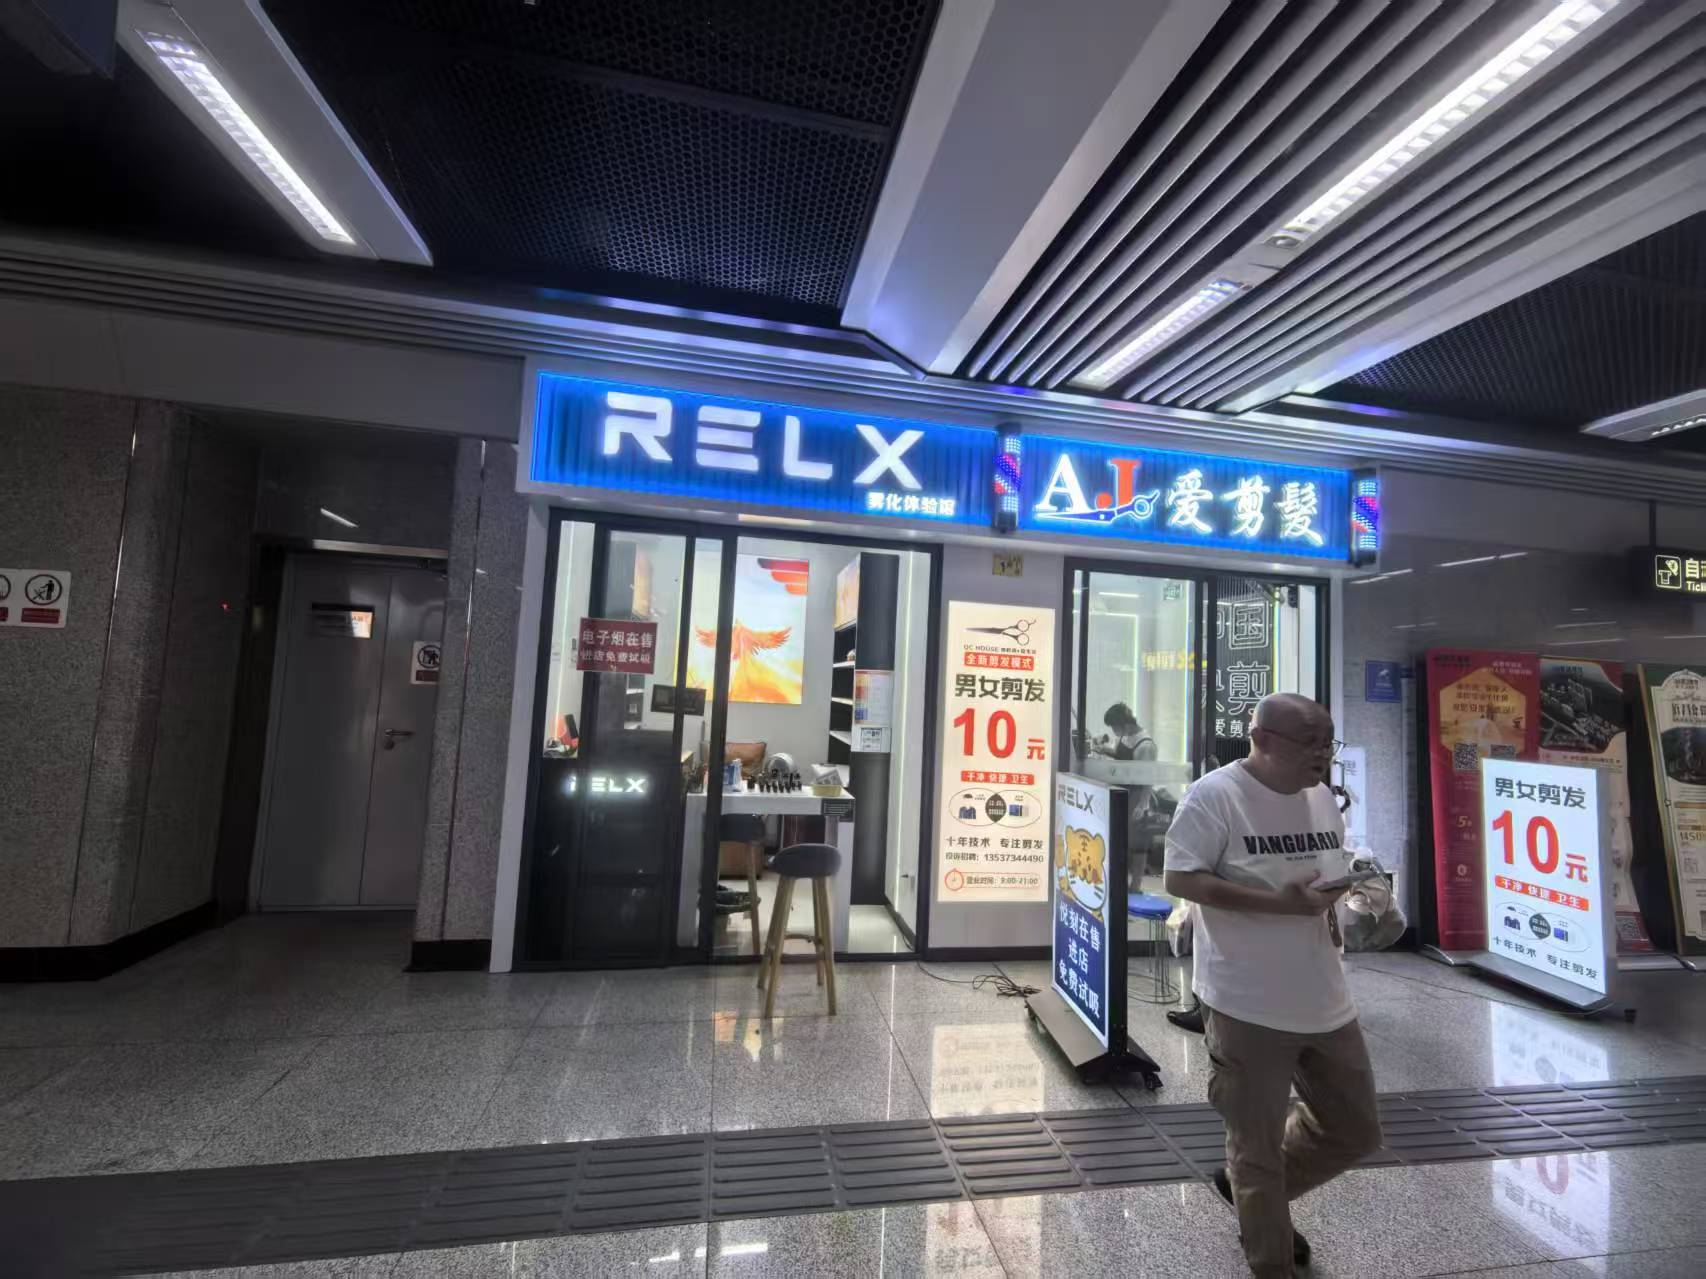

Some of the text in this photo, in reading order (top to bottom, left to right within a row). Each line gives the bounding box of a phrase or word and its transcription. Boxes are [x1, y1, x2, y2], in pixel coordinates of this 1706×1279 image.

[603, 391, 924, 490] RELX
[582, 629, 654, 648] 电子烟在售
[954, 673, 1046, 702] 男女剪发
[570, 776, 647, 793] ELX
[1058, 783, 1095, 814] RELX
[1495, 777, 1586, 809] 男女剪发
[945, 836, 1044, 850] 十年技术 专注剪发
[1243, 831, 1340, 854] VANGUARD
[1059, 900, 1101, 953] 悦刻在售
[1068, 937, 1089, 975] 进店
[1493, 936, 1600, 979] 十年技术 专注剪发
[1058, 958, 1101, 1019] 免费试吸
